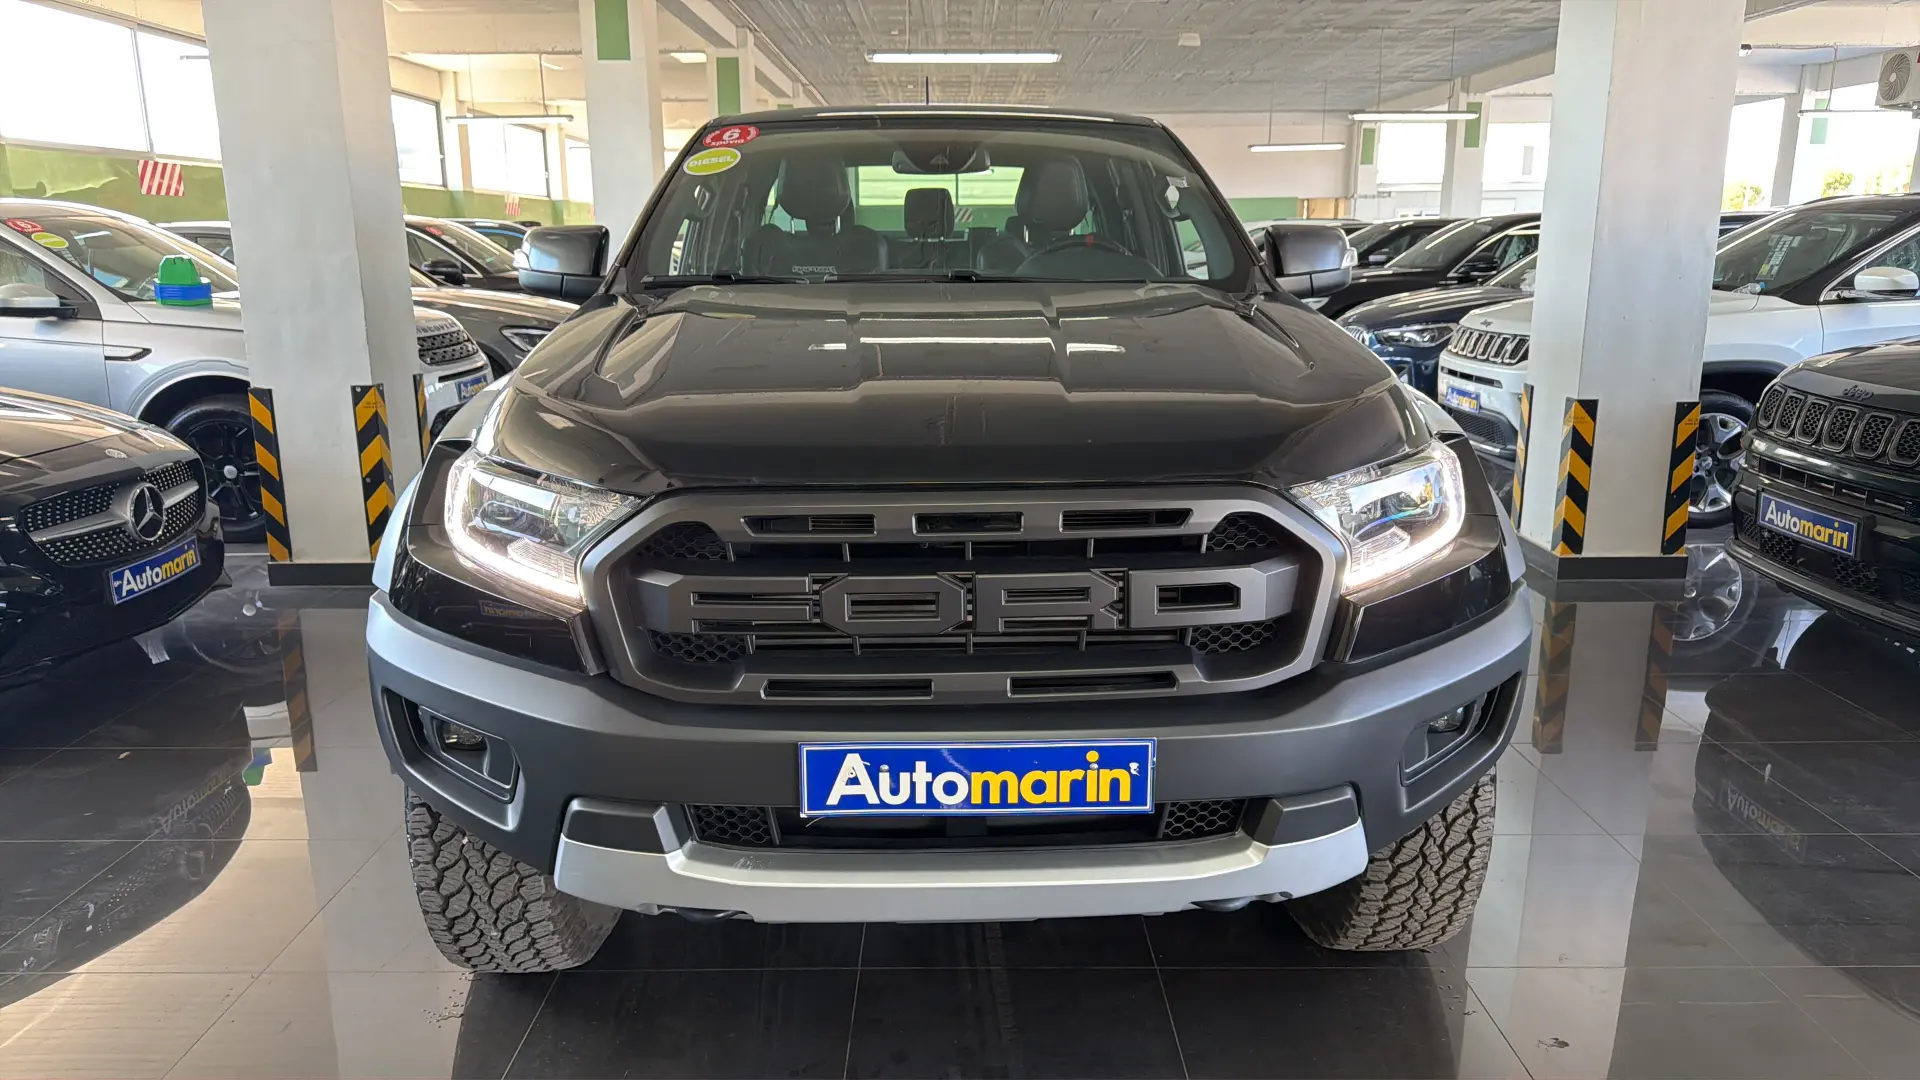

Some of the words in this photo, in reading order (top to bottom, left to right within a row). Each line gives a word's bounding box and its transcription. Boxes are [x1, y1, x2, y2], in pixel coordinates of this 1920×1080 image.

[722, 128, 742, 140] 6
[689, 155, 735, 167] DIESEL
[1765, 500, 1849, 549] Automarin
[121, 544, 197, 597] Automarin
[633, 563, 1299, 634] FORD
[825, 750, 1131, 806] Automarin
